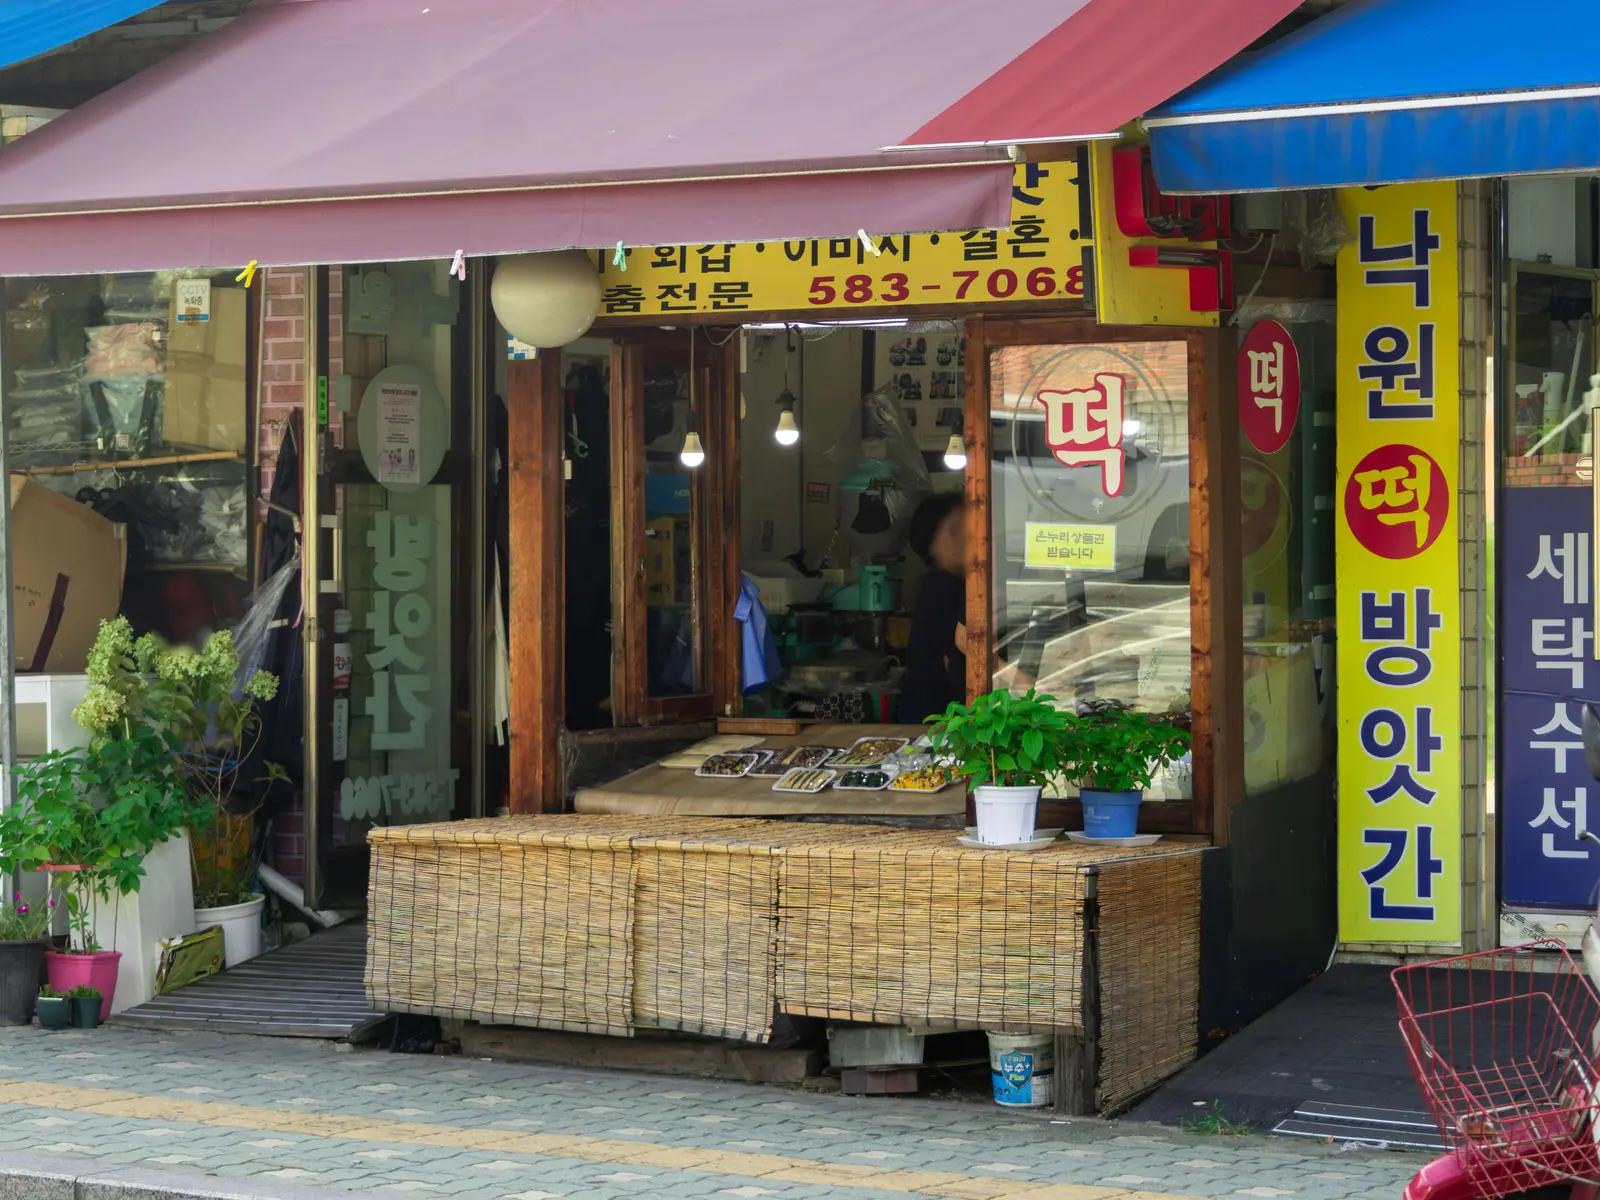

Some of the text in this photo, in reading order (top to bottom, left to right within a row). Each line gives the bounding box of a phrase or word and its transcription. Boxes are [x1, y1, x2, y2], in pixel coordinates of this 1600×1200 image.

[179, 285, 208, 296] CCTV
[808, 265, 1084, 305] 583-7068
[184, 296, 204, 306] 녹화중
[1246, 341, 1285, 434] 떡
[1037, 372, 1126, 499] 떡
[1035, 530, 1070, 544] 온누리
[1047, 546, 1094, 559] 받습니다
[1354, 208, 1444, 923] 낙원 떡 방앗간
